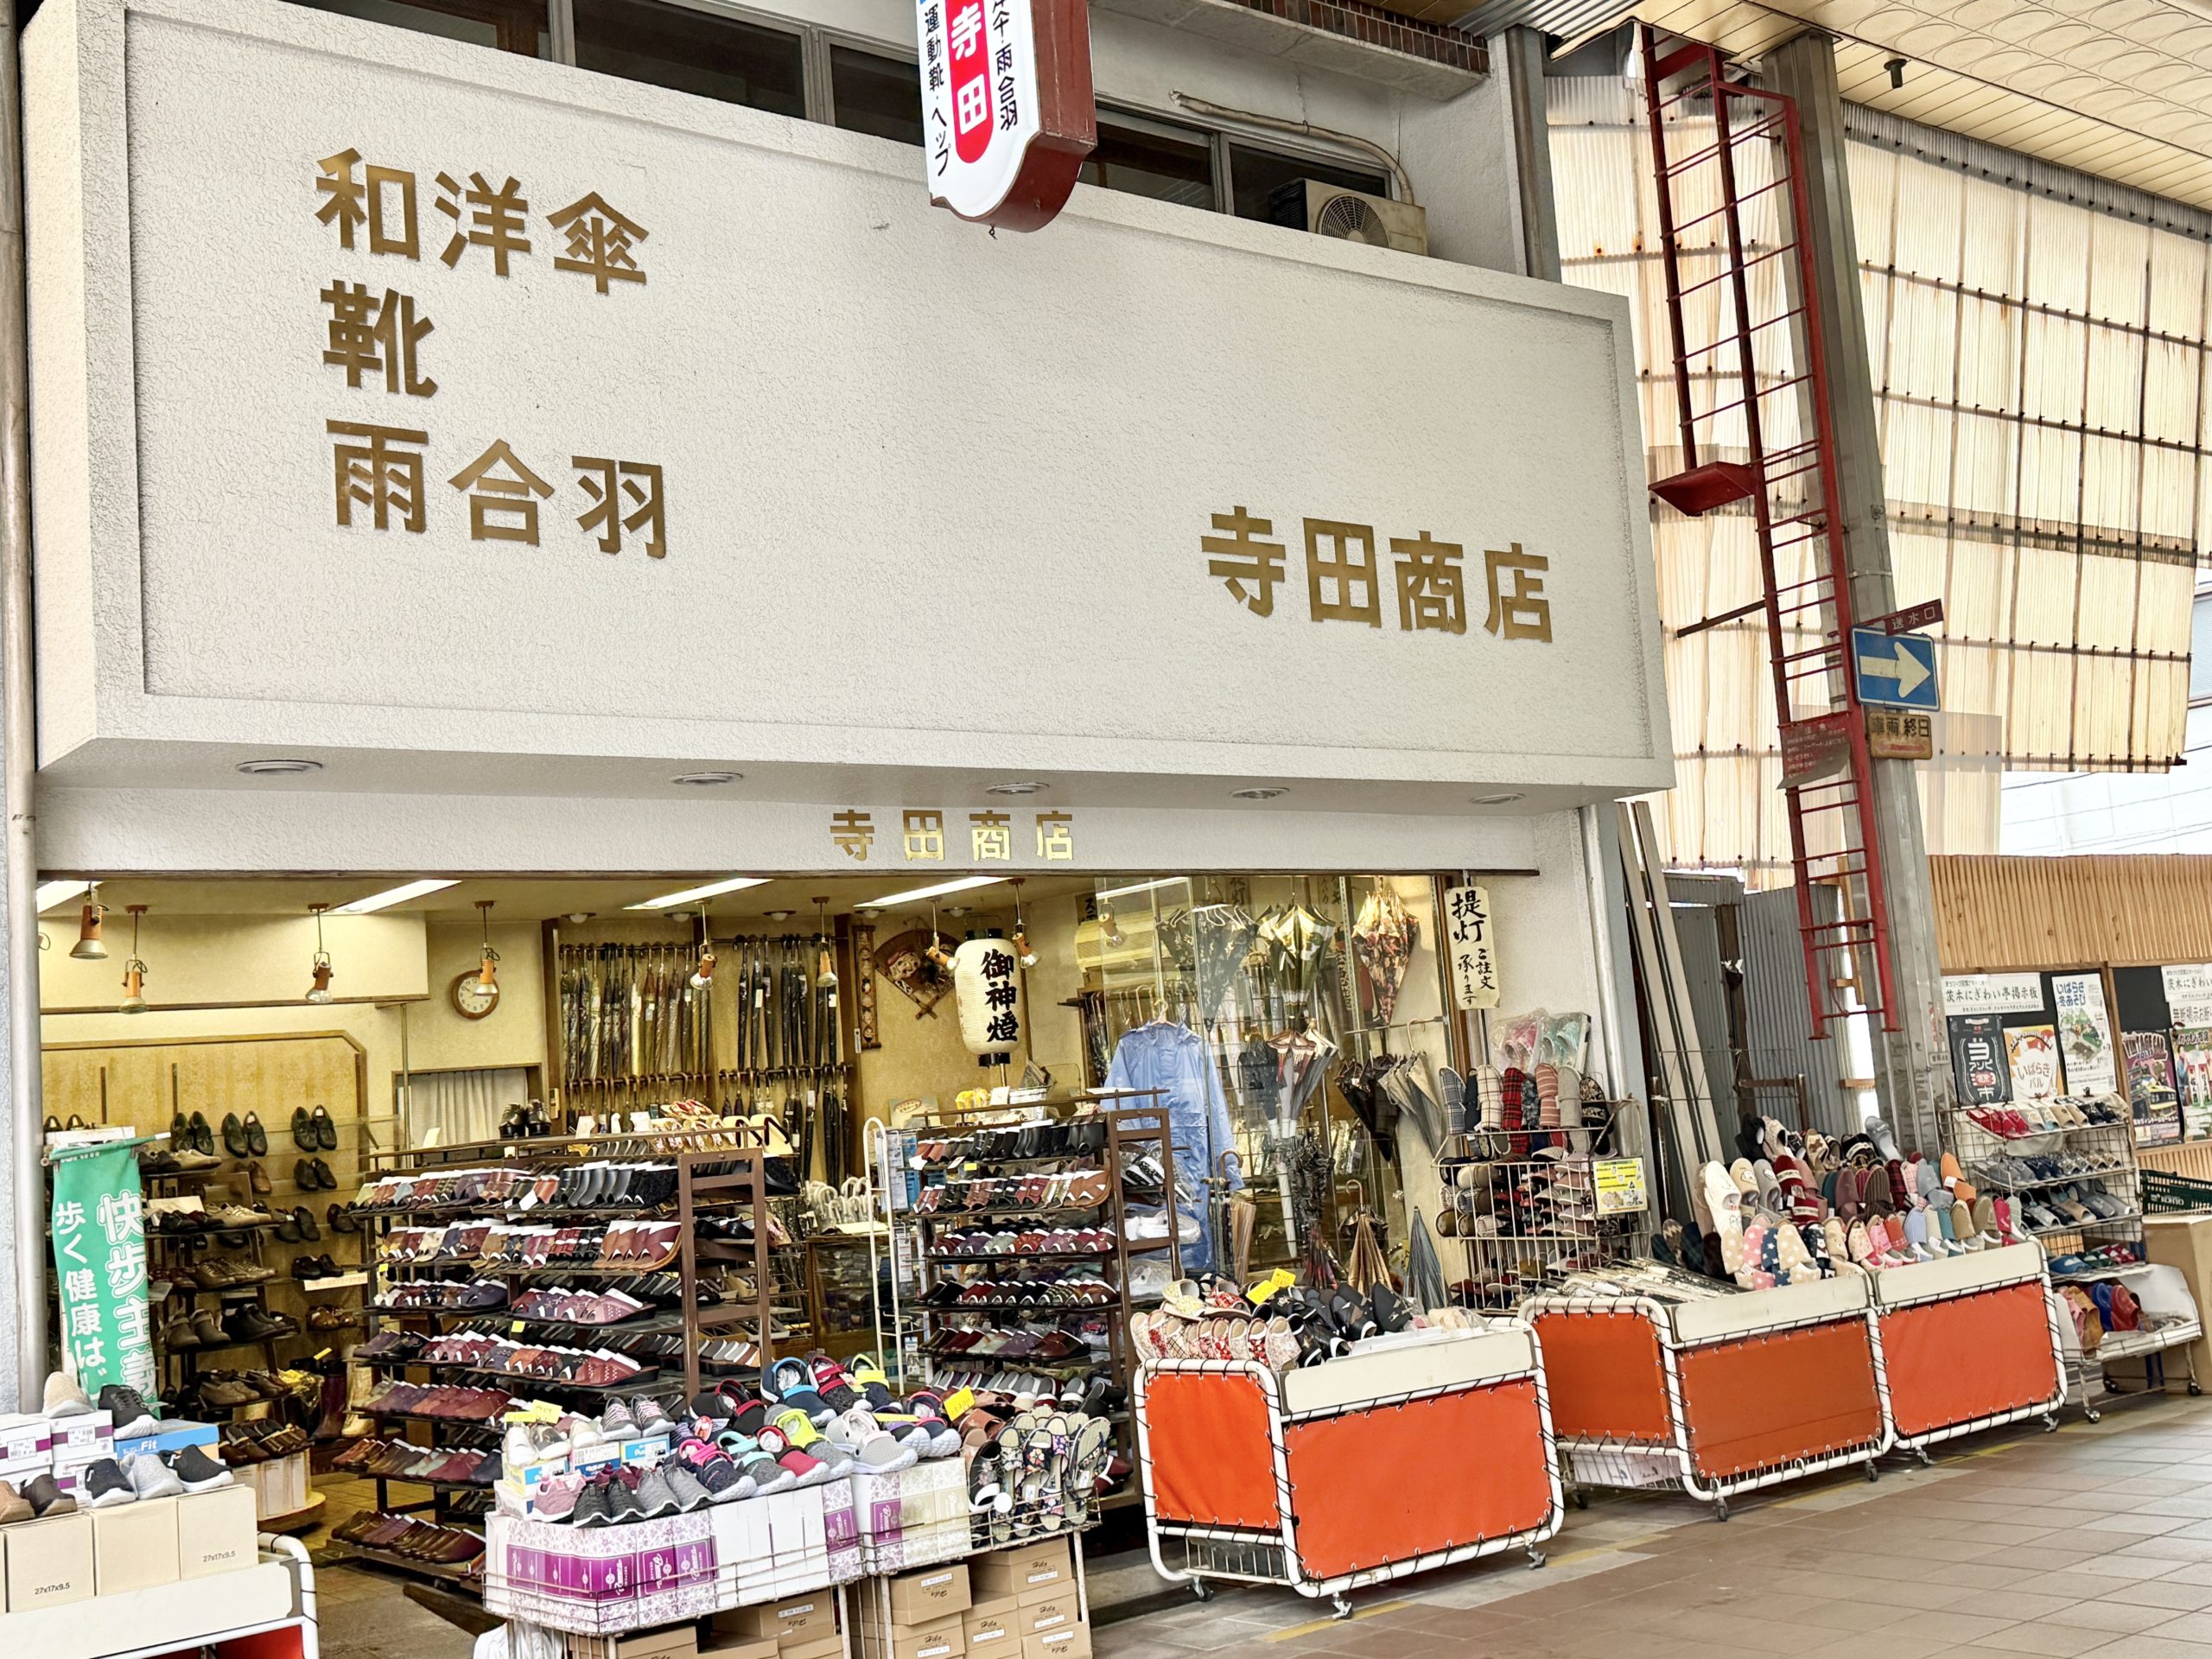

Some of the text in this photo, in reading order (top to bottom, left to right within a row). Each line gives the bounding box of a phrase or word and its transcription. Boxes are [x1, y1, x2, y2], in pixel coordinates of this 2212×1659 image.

[315, 147, 650, 296] 和洋傘
[321, 279, 439, 398] 靴
[326, 418, 667, 560] 雨合羽
[1200, 505, 1554, 644] 寺田商店
[1891, 607, 1936, 630] 送水口
[1871, 716, 1930, 738] 車両終日
[829, 809, 1074, 861] 寺田商店
[1451, 889, 1488, 944] 提灯
[1458, 953, 1478, 1006] 承ります
[1475, 948, 1496, 990] ご註文
[980, 948, 1020, 1043] 御神燈
[1945, 985, 2039, 1003] 茨木にぎわい亭掲示板
[2017, 1062, 2051, 1080] いばらき
[140, 1440, 158, 1452] Fit
[202, 1550, 236, 1562] 27x17x9.5
[34, 1581, 71, 1595] 27x17x9.5
